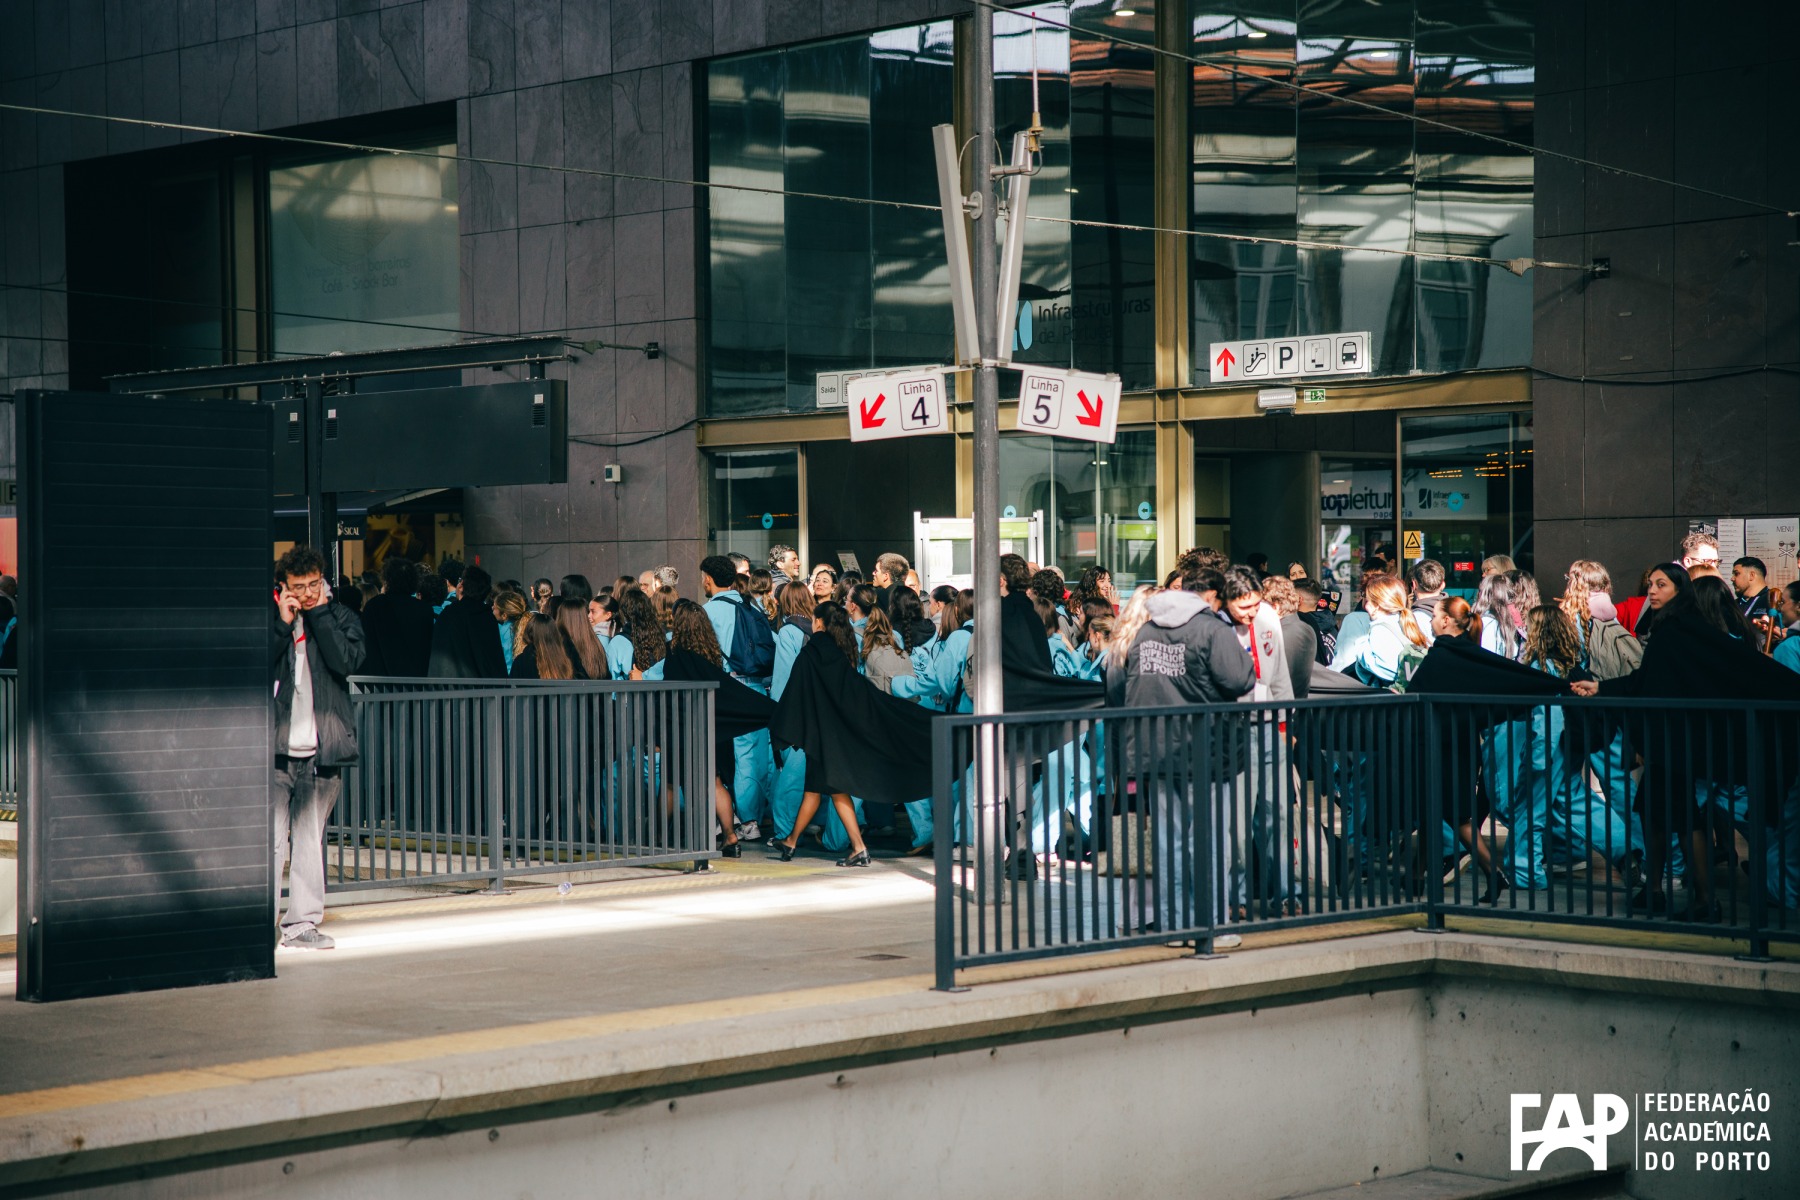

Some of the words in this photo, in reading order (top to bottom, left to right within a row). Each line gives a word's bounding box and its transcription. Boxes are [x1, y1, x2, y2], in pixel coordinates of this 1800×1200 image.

[382, 273, 399, 288] Bar
[1279, 346, 1294, 370] P
[903, 383, 933, 396] Linha
[1031, 378, 1059, 393] Linha
[911, 396, 930, 426] 4
[1032, 394, 1052, 425] 5
[1776, 525, 1795, 533] MENU
[1140, 640, 1186, 654] INSTITUTO
[1140, 648, 1185, 663] SUPERIOR
[1153, 662, 1187, 677] PORTO
